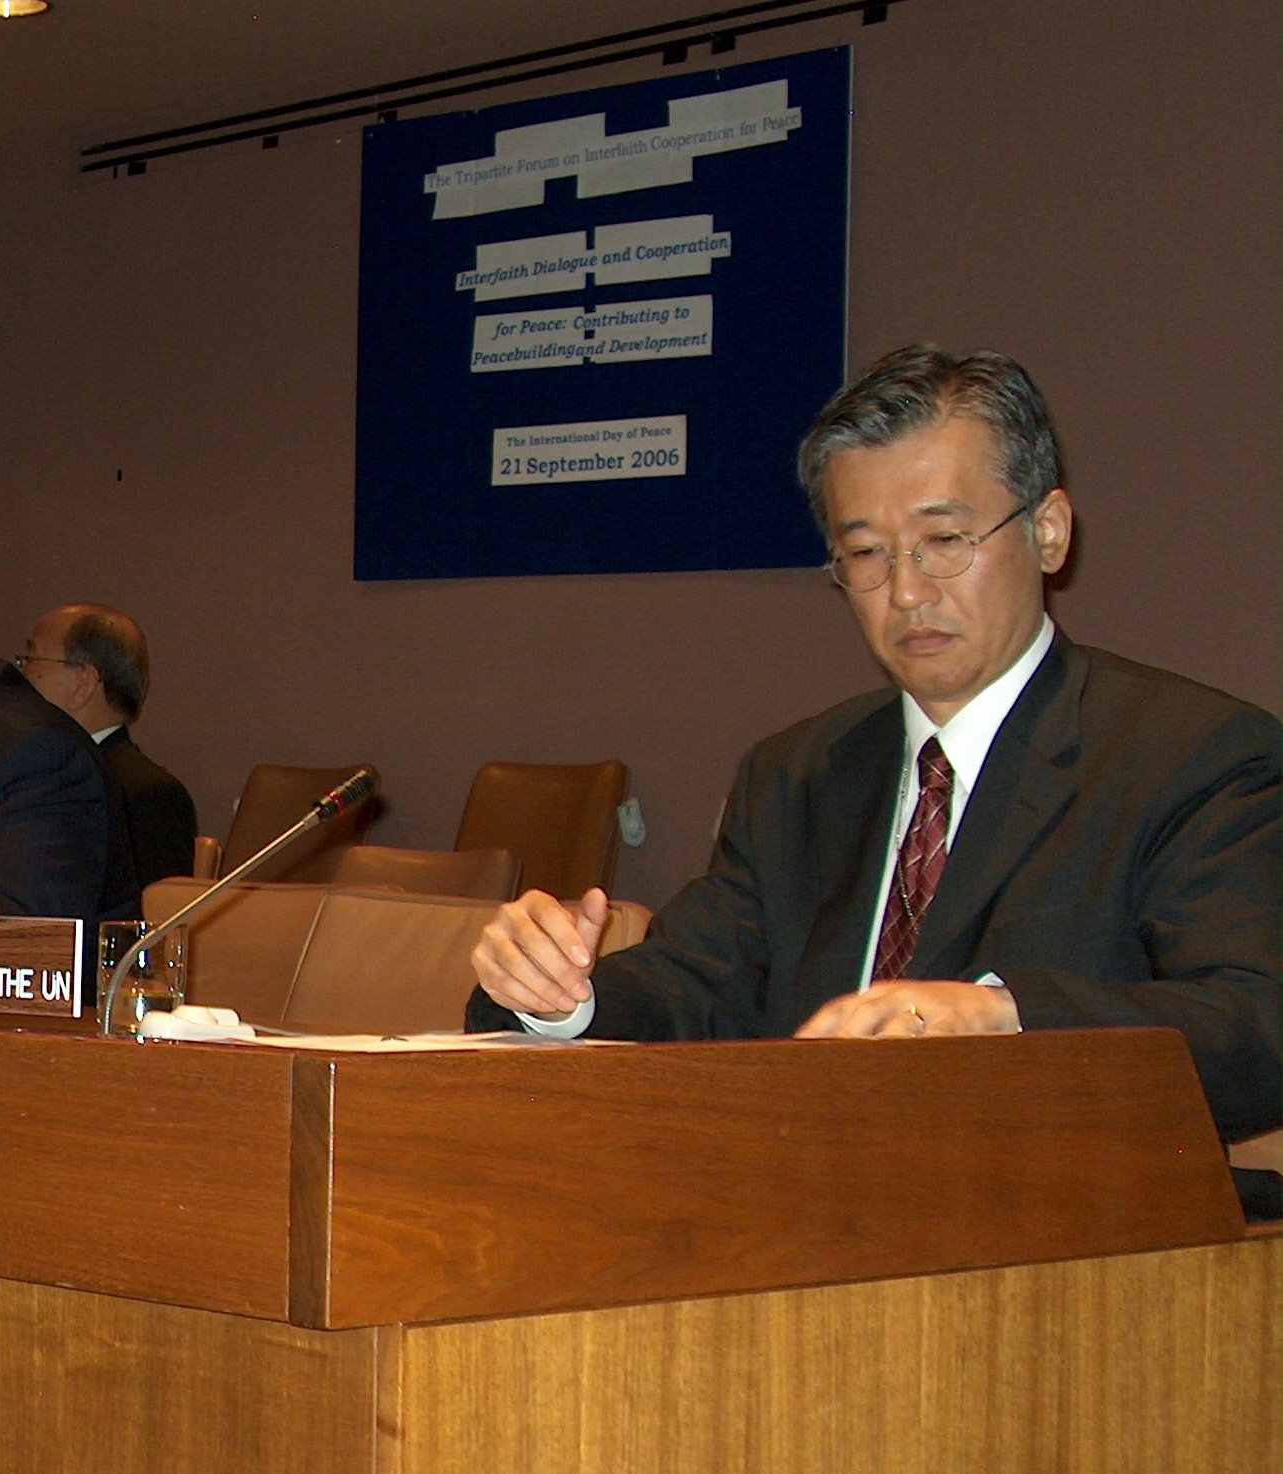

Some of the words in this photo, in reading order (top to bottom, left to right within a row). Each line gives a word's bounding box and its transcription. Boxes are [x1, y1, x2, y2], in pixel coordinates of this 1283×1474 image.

[427, 174, 451, 189] The
[455, 163, 514, 185] Tripartite
[517, 155, 560, 174] Forum
[563, 153, 580, 167] on
[584, 140, 648, 163] Interfaith
[651, 124, 735, 153] Cooperation
[740, 121, 757, 137] for
[762, 112, 799, 133] Peace
[459, 265, 529, 287] Interfaith
[533, 255, 597, 277] Dialogue
[602, 247, 632, 265] and
[636, 235, 729, 262] Cooperation
[492, 321, 517, 341] for
[519, 317, 567, 335] Peace:
[573, 304, 671, 330] Contributing
[674, 305, 691, 320] to
[609, 332, 708, 354] Development
[506, 436, 526, 448] The
[530, 431, 600, 447] International
[602, 429, 624, 443] Day
[627, 427, 638, 440] of
[641, 426, 673, 438] Peace
[500, 457, 522, 476] 21
[526, 452, 626, 478] September
[631, 448, 680, 469] 2006
[41, 969, 72, 1002] UN
